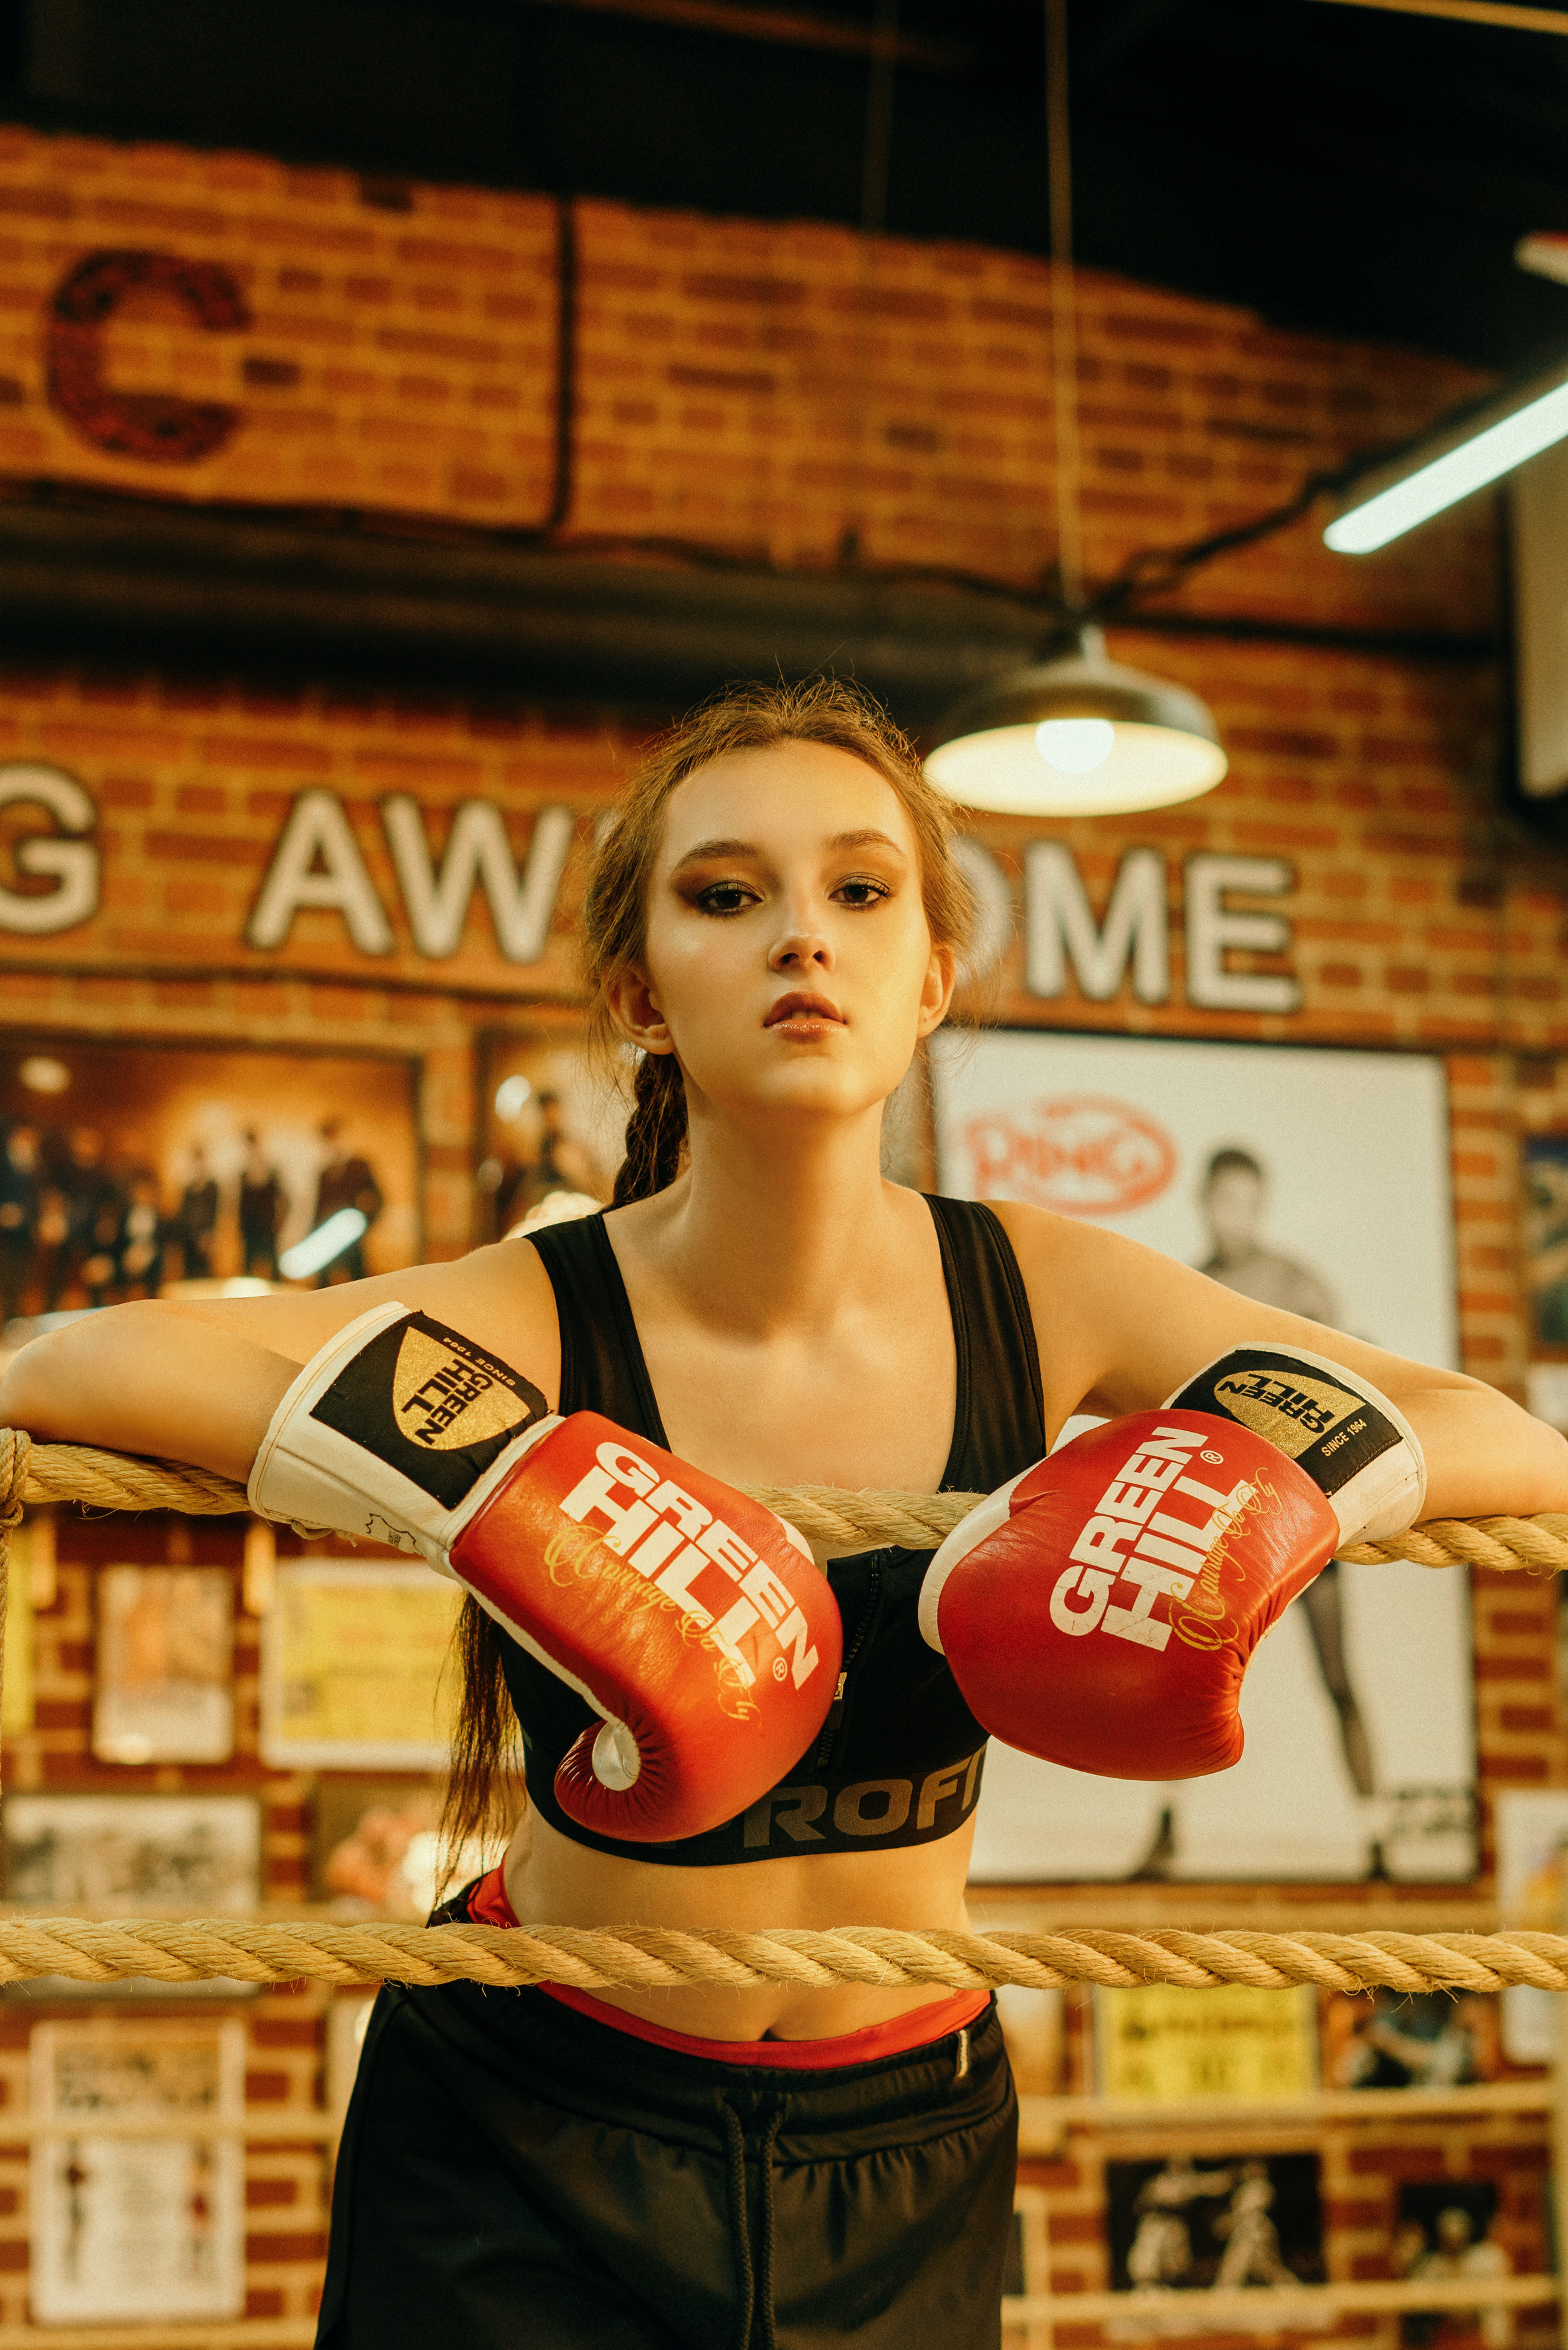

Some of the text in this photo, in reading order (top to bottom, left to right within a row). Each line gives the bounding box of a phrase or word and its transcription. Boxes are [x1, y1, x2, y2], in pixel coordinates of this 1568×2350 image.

[401, 1358, 476, 1413] HILL
[442, 1337, 517, 1387] SINCE 1964
[415, 1372, 493, 1446] GREEN
[1216, 1380, 1325, 1433] GREEN
[1247, 1372, 1336, 1424] HILL
[1321, 1418, 1368, 1457] SINCE 1964
[1049, 1426, 1210, 1637] GREEN
[1100, 1475, 1258, 1652] HILL
[558, 1465, 757, 1690] HILL
[596, 1441, 819, 1691] GREEN
